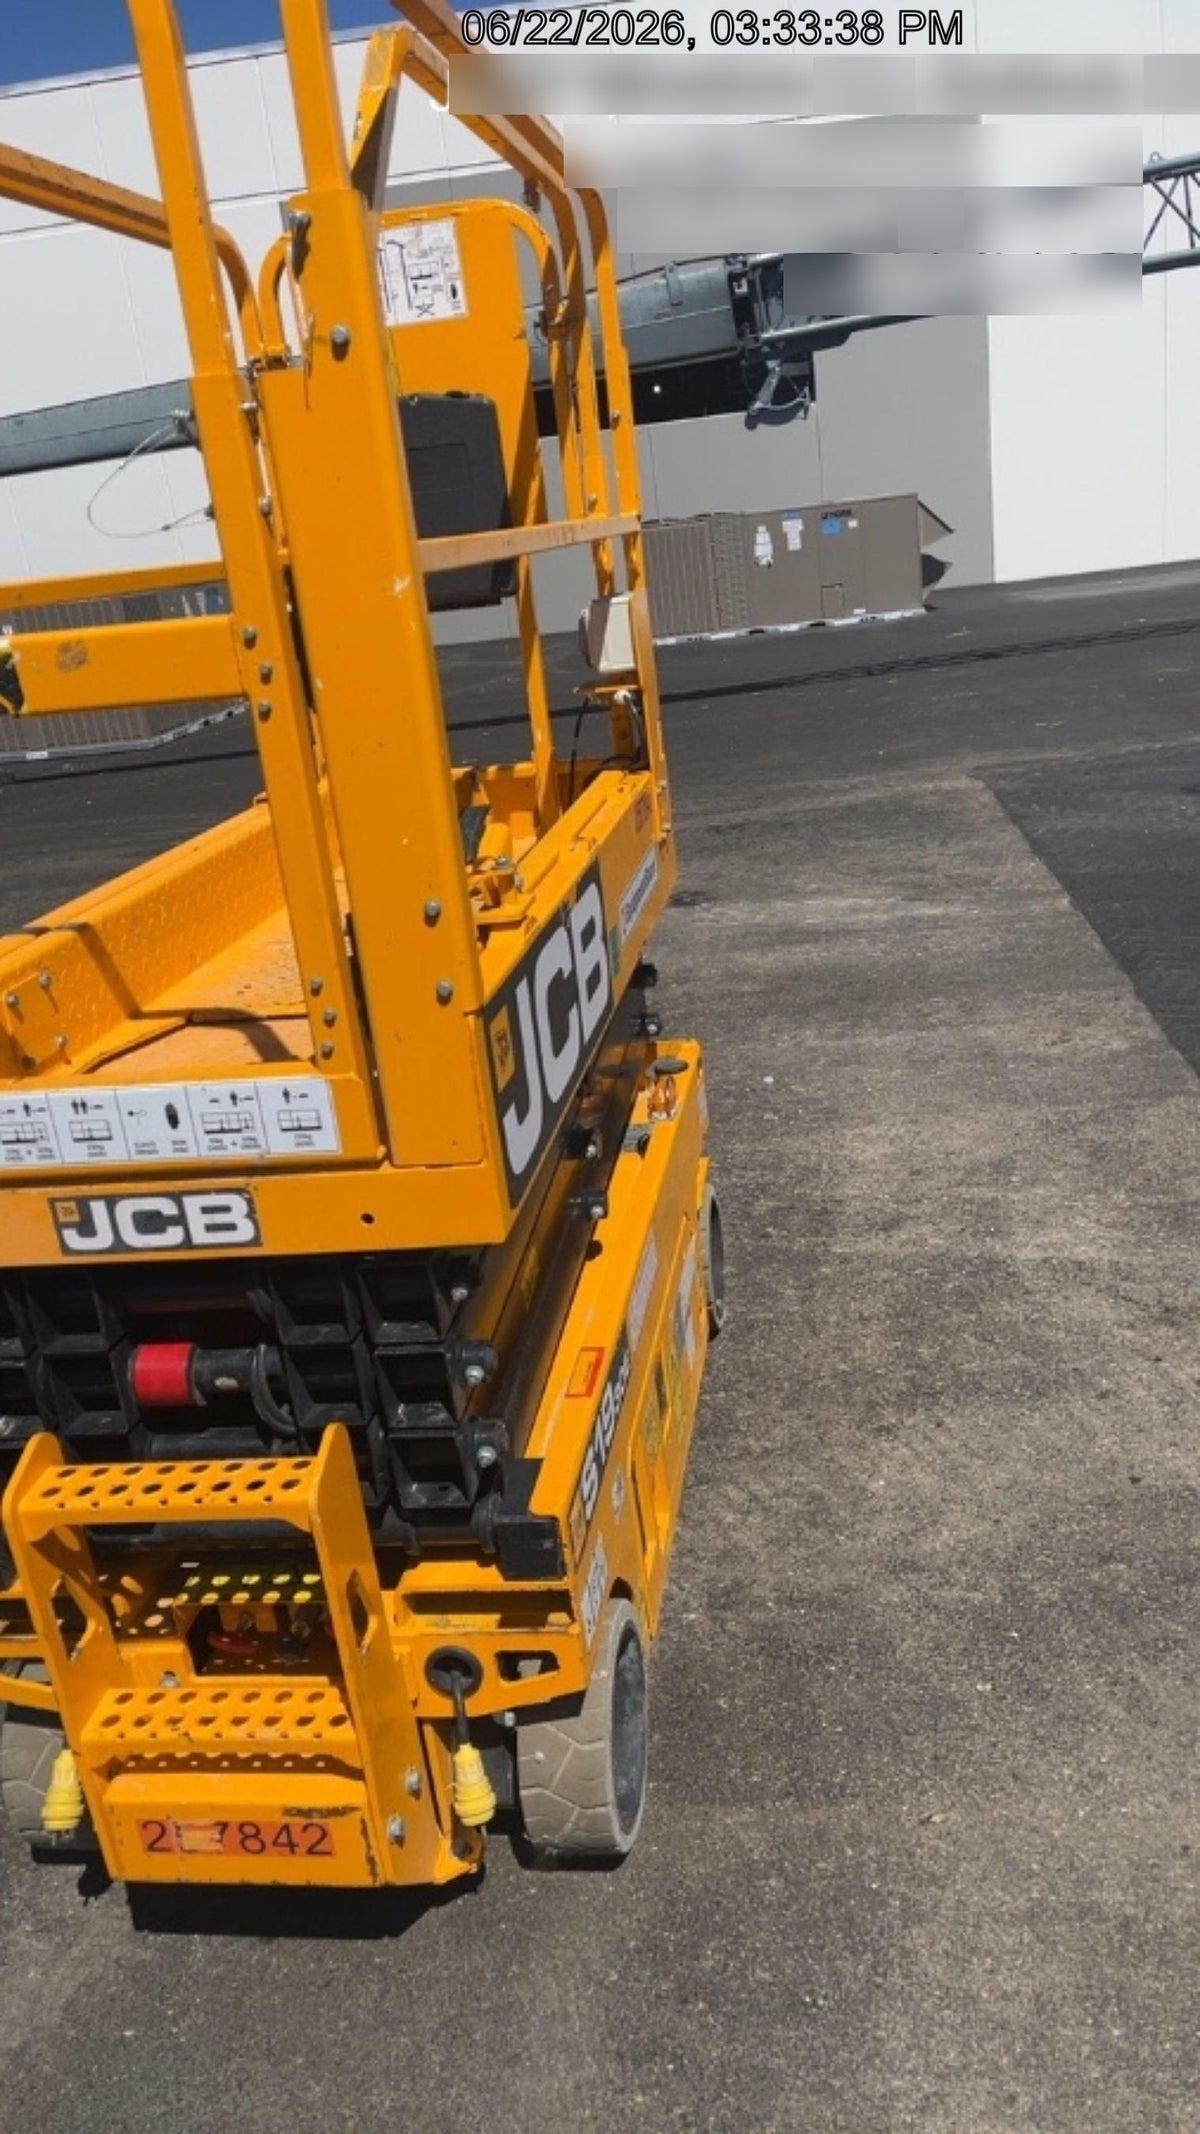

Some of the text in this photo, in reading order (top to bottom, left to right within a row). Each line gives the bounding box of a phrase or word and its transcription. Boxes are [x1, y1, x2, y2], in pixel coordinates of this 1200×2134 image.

[502, 881, 610, 1176] JCB
[61, 1192, 255, 1252] JCB
[142, 1820, 333, 1855] 27842
